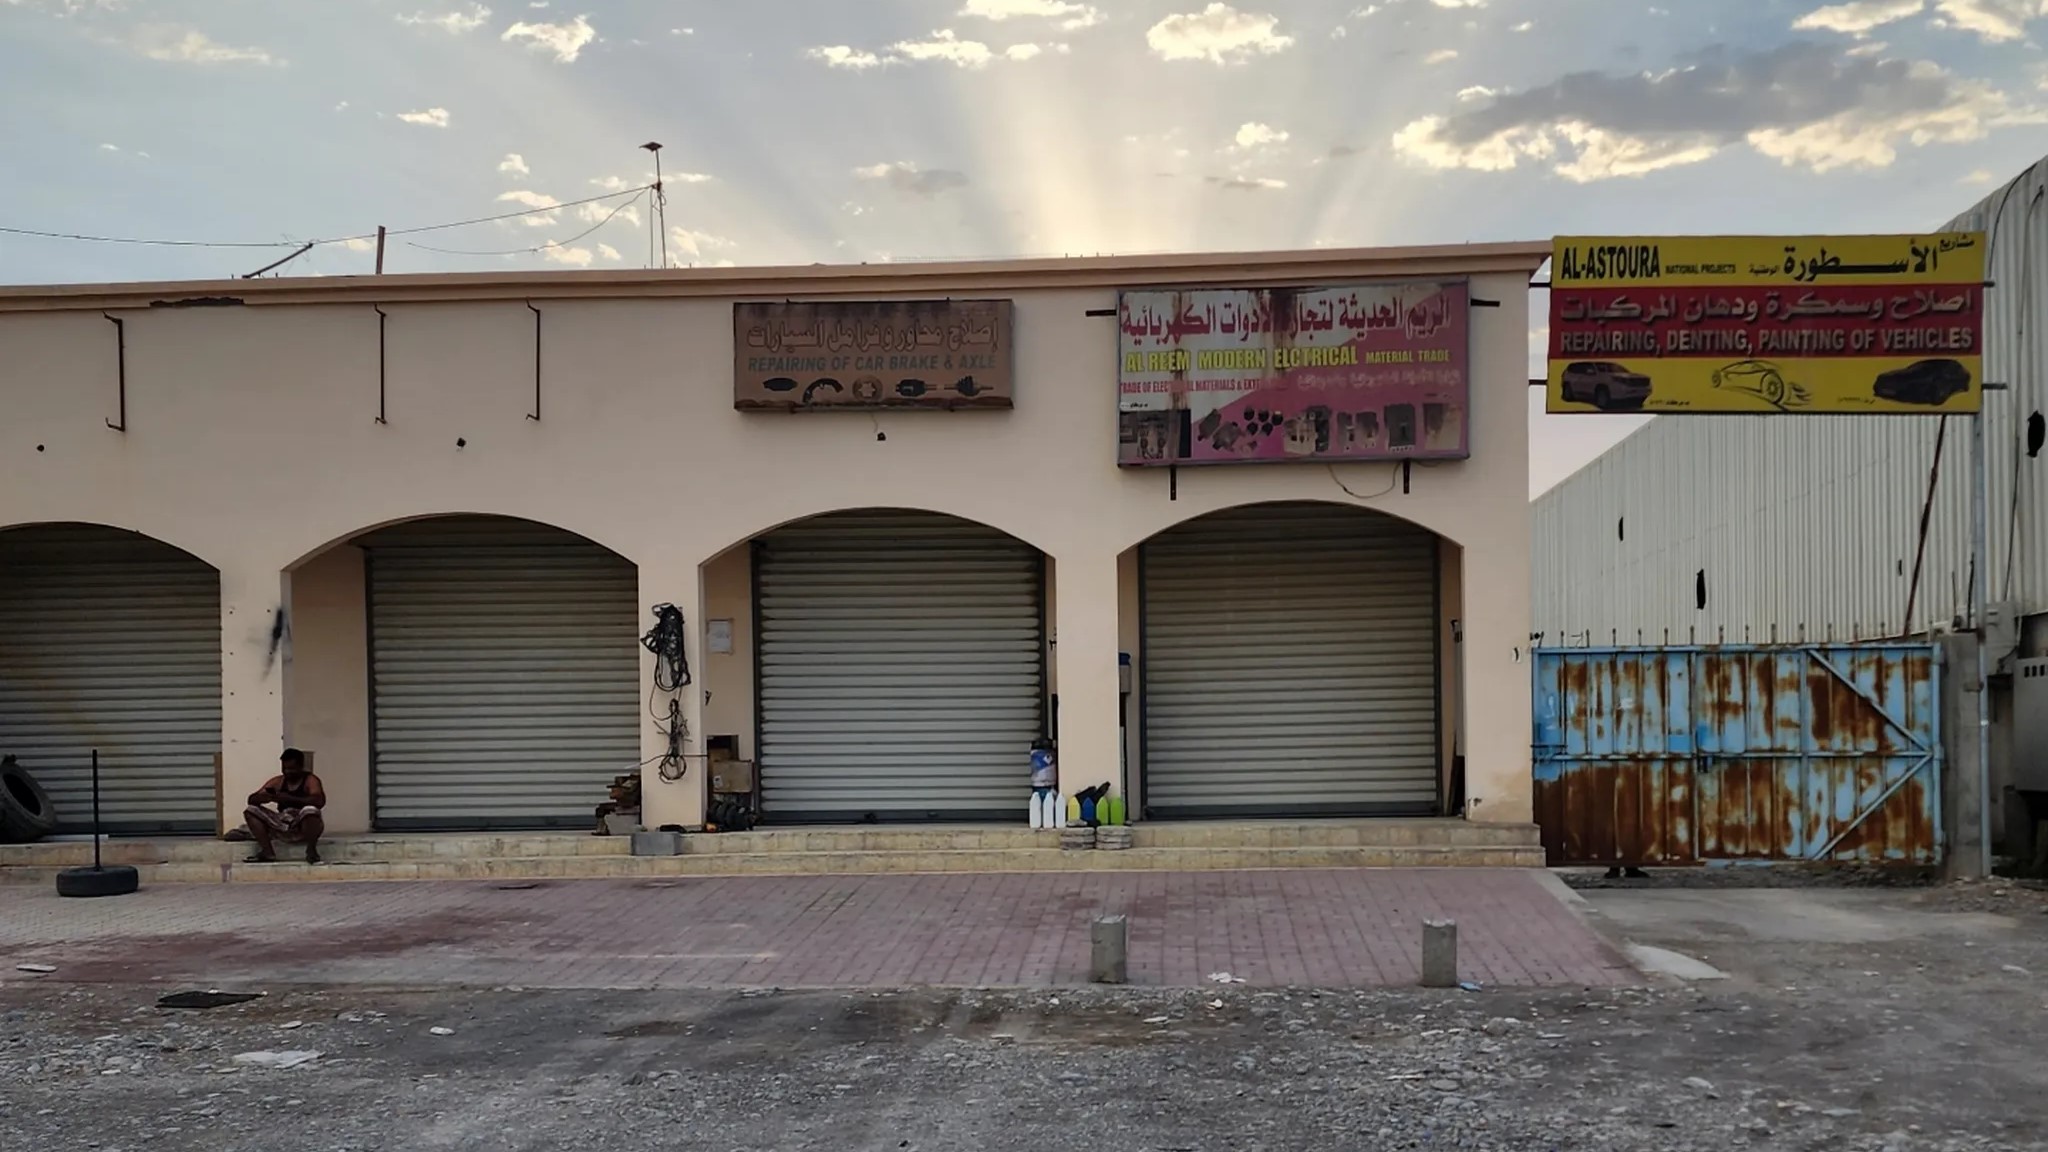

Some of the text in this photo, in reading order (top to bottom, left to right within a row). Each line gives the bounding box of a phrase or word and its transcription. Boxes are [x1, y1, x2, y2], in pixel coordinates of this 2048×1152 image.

[1561, 246, 1736, 279] AL-ASTOURA NATIONAL PROJECTS
[1339, 293, 1404, 339] الحديثة
[1406, 295, 1450, 339] الريم
[1560, 294, 1677, 326] المركبات
[1683, 294, 1759, 322] ودهان
[1765, 291, 1884, 321] وسمكرة
[747, 320, 826, 353] السيارات
[1121, 304, 1216, 345] الكهربائية
[1560, 327, 1973, 354] REPAIRING, DENTING, PAINTING OF VEHICLES
[748, 355, 997, 372] REPAIRING OF CAR BRAKE & AXLE
[1125, 345, 1450, 372] AL REEM MODERN ELCTRICAL MATERIAL TRADE
